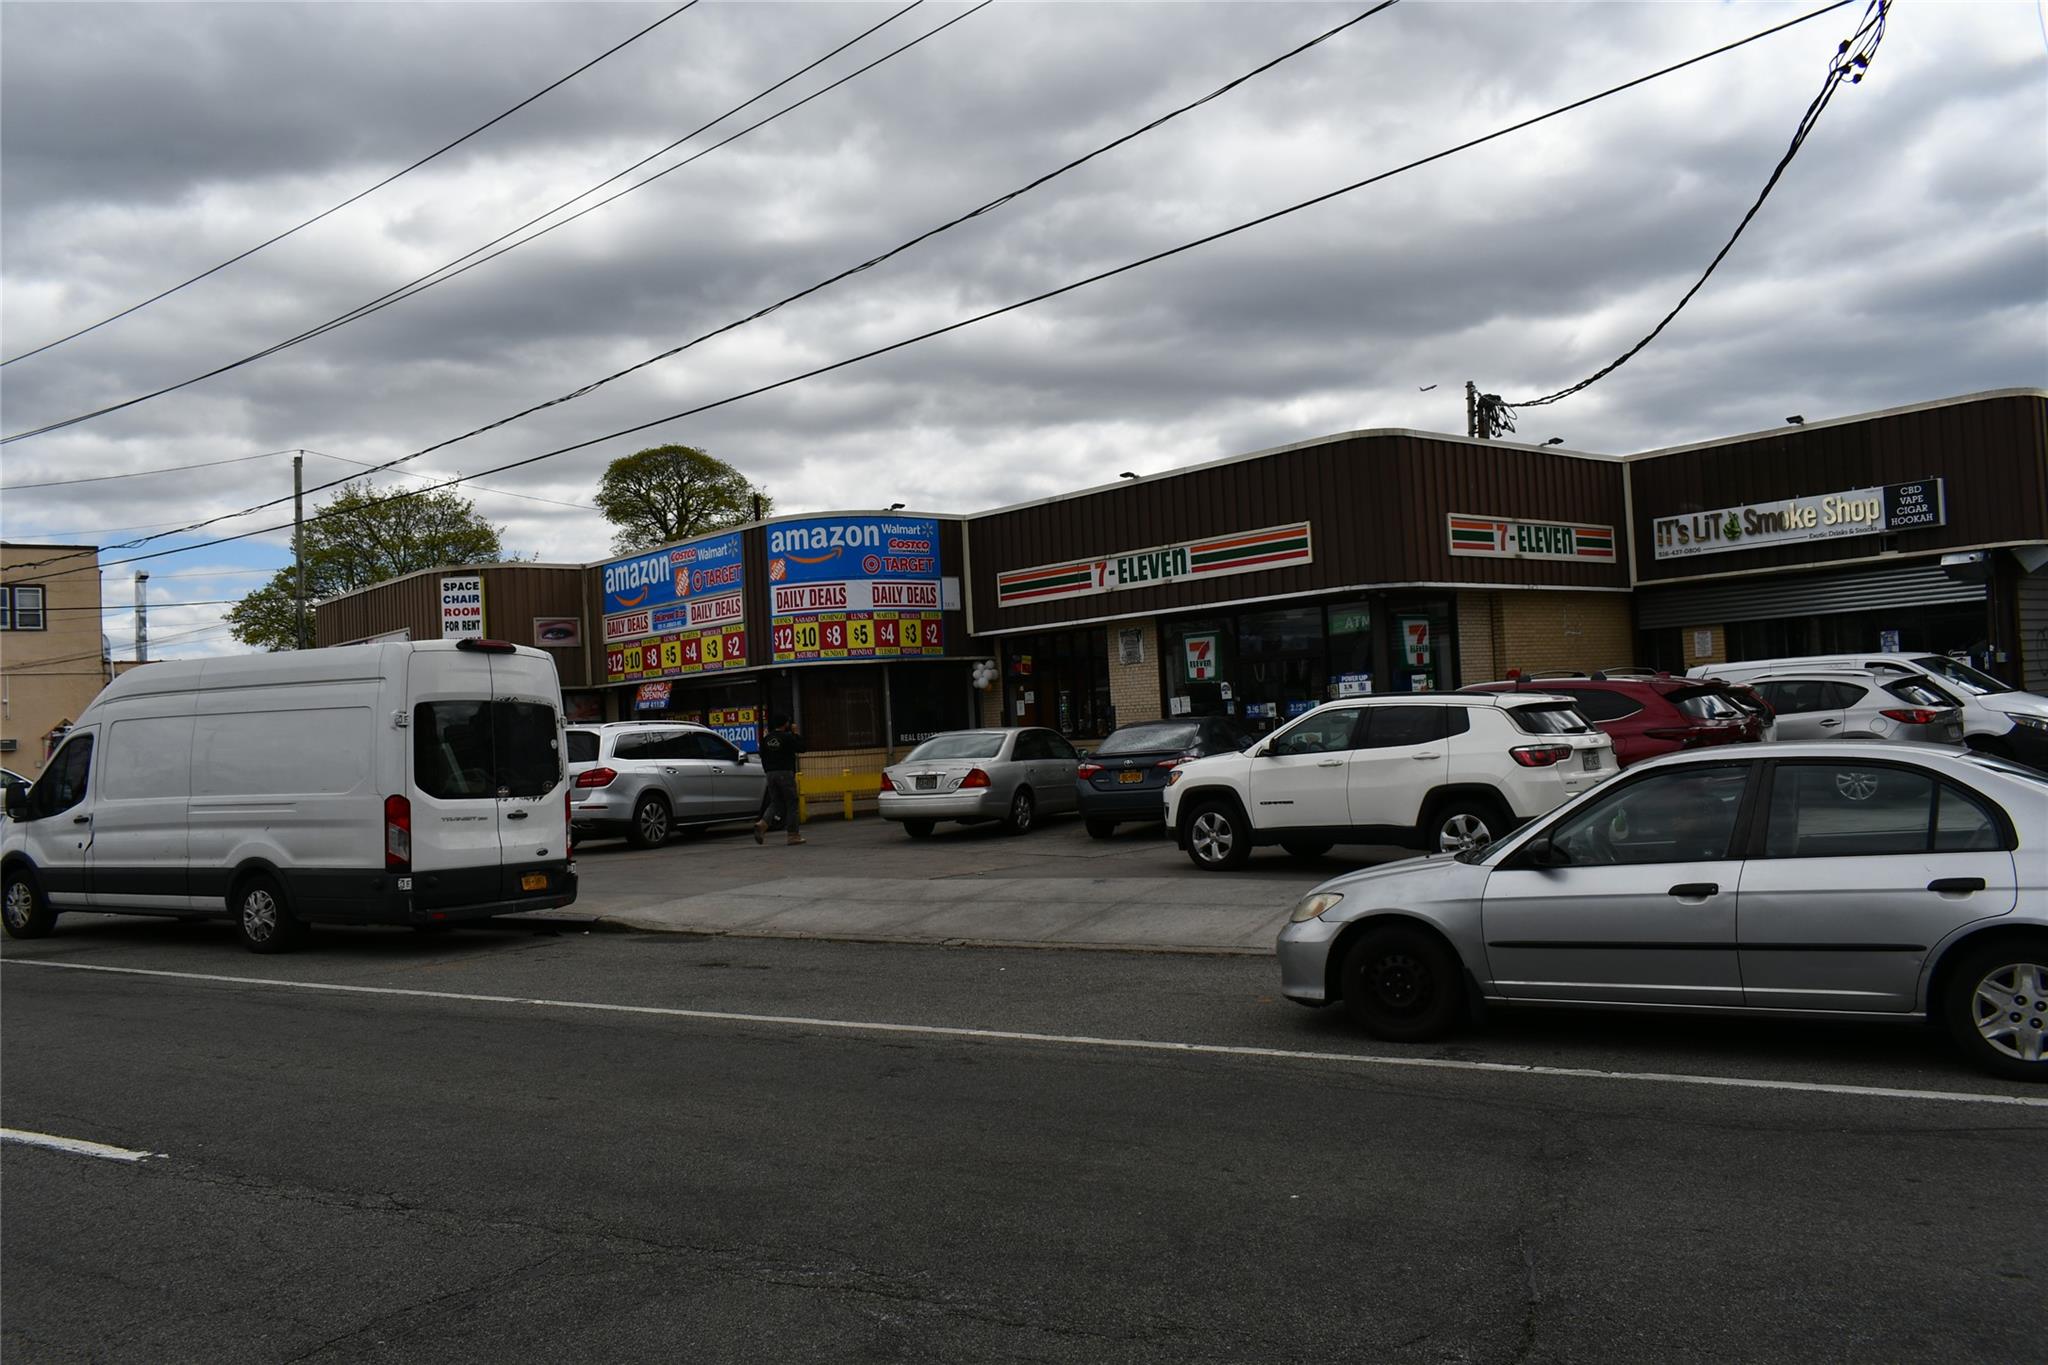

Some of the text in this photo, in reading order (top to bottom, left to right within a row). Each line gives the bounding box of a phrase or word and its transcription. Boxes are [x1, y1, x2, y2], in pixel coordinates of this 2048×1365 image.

[1900, 485, 1922, 495] CBD
[1900, 495, 1924, 505] VAPE
[1743, 503, 1817, 535] Smoke
[1822, 496, 1880, 526] Shop
[1896, 504, 1928, 516] CIGAR
[1891, 513, 1933, 526] HOOKAH
[771, 523, 921, 553] amazon Walmart
[1829, 529, 1848, 537] Drinks
[1855, 526, 1877, 534] Snacks
[888, 538, 931, 549] COSTCO
[671, 544, 728, 562] COSTCO Walmart
[882, 557, 934, 573] TARGET
[605, 555, 670, 593] amazon
[704, 563, 742, 587] TARGET
[443, 581, 479, 591] SPACE
[443, 594, 480, 604] CHAIR
[776, 586, 847, 609] DAILY DEALS
[872, 586, 936, 604] DAILY DEALS
[444, 607, 480, 616] ROOM
[691, 604, 713, 621] DAILY
[716, 598, 740, 617] DEALS
[445, 619, 480, 631] FOR RENT
[607, 619, 625, 635] DAILY
[627, 615, 648, 632] DEALS
[1345, 615, 1370, 629] ATM
[774, 623, 938, 649] $12 $10 $8 $5 $4 $3 $2
[608, 636, 739, 672] $12 $10 $8 $5 $4 $3 $2
[644, 682, 665, 691] GRAND
[641, 690, 670, 700] OPENING
[900, 733, 916, 742] REAL
